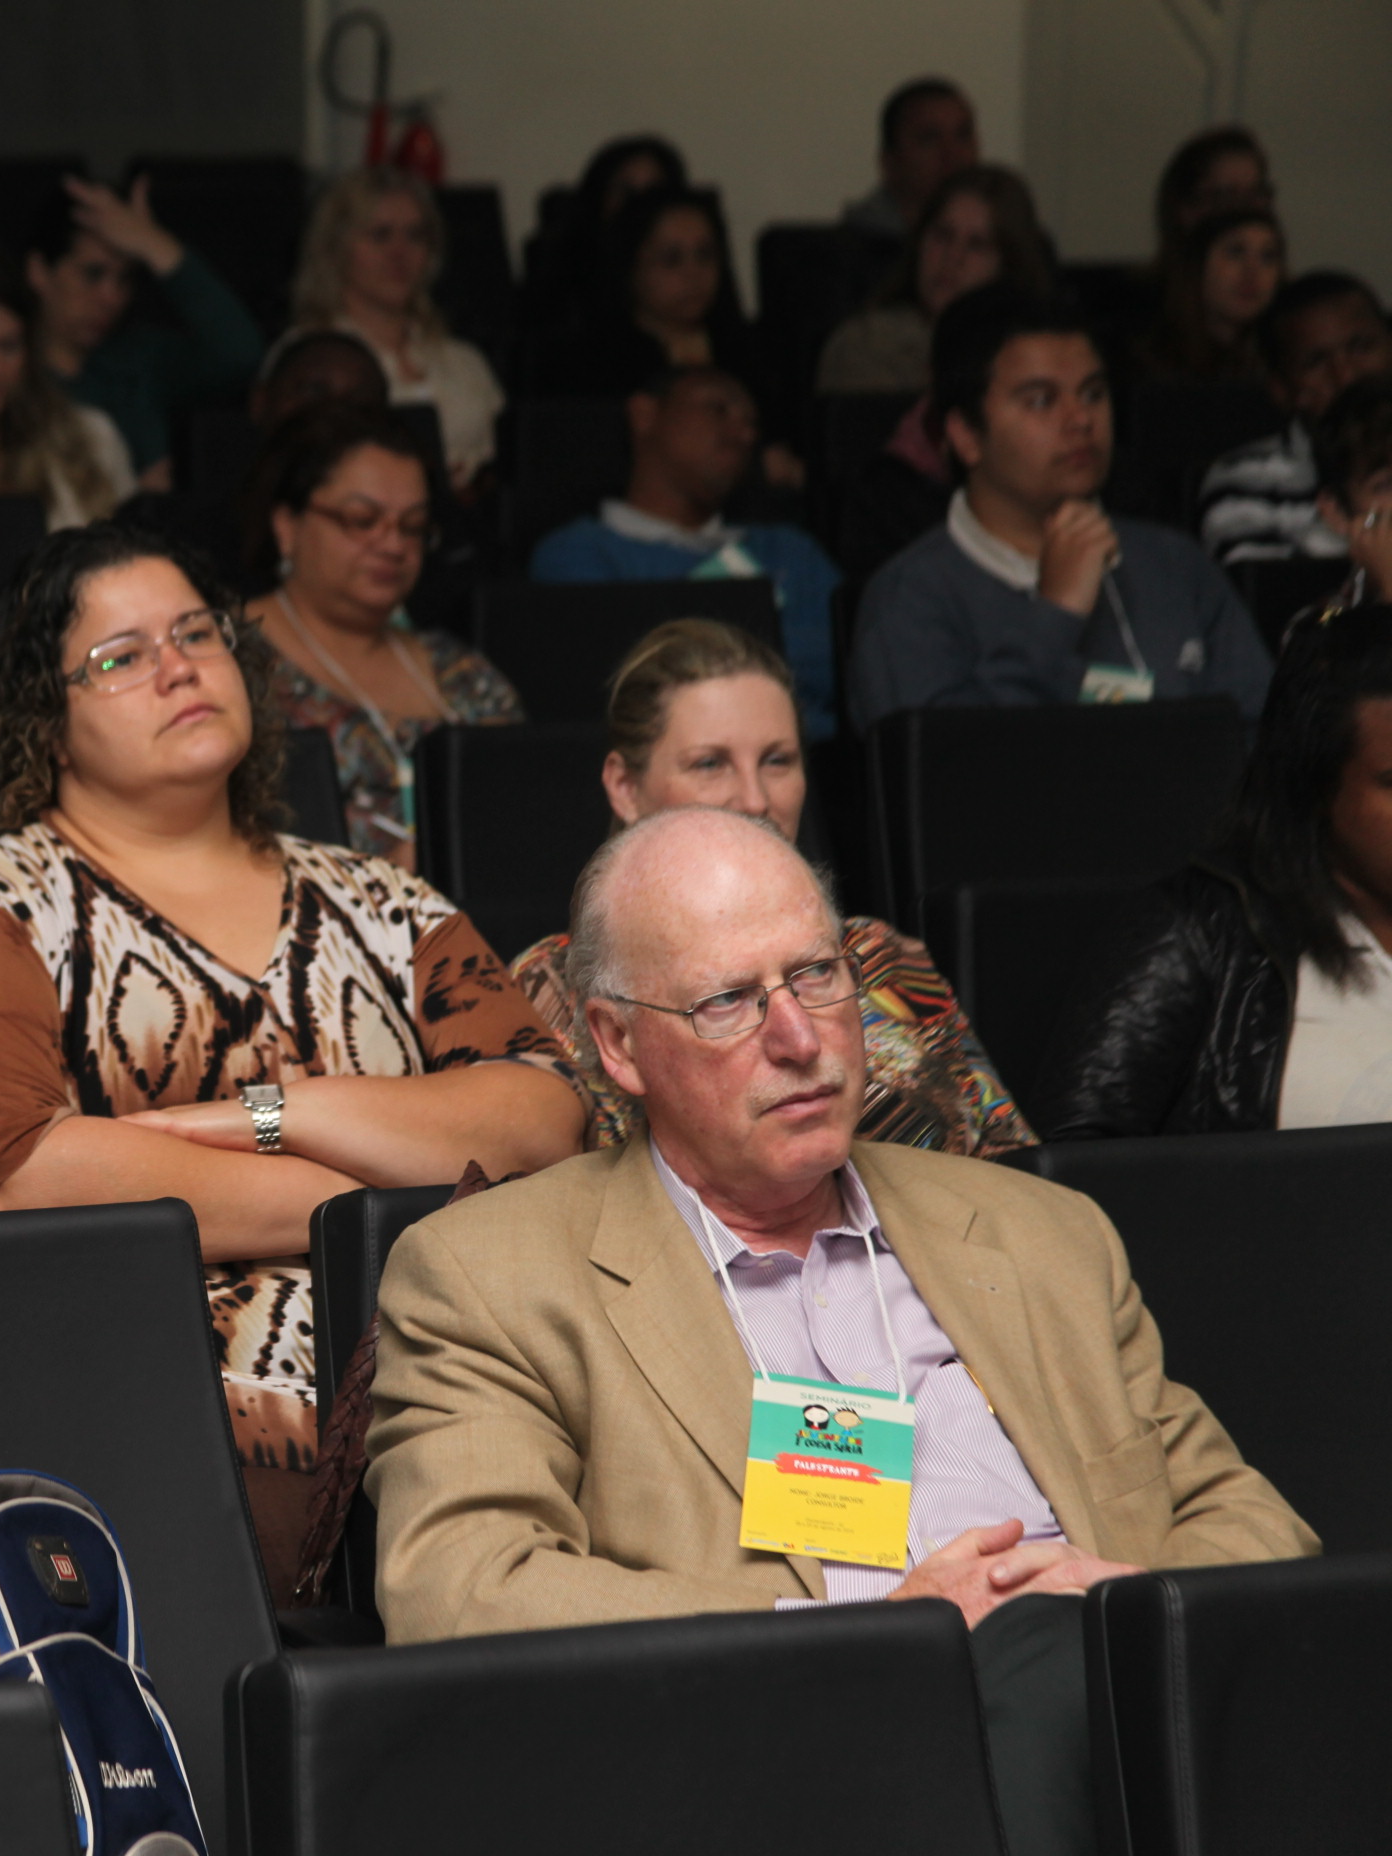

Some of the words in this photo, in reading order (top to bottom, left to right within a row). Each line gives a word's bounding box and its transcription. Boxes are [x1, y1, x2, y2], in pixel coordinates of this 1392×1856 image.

[799, 1391, 872, 1410] SEMINÁRIO
[793, 1459, 861, 1478] PALESTRANTE
[98, 1760, 157, 1789] Wilson
